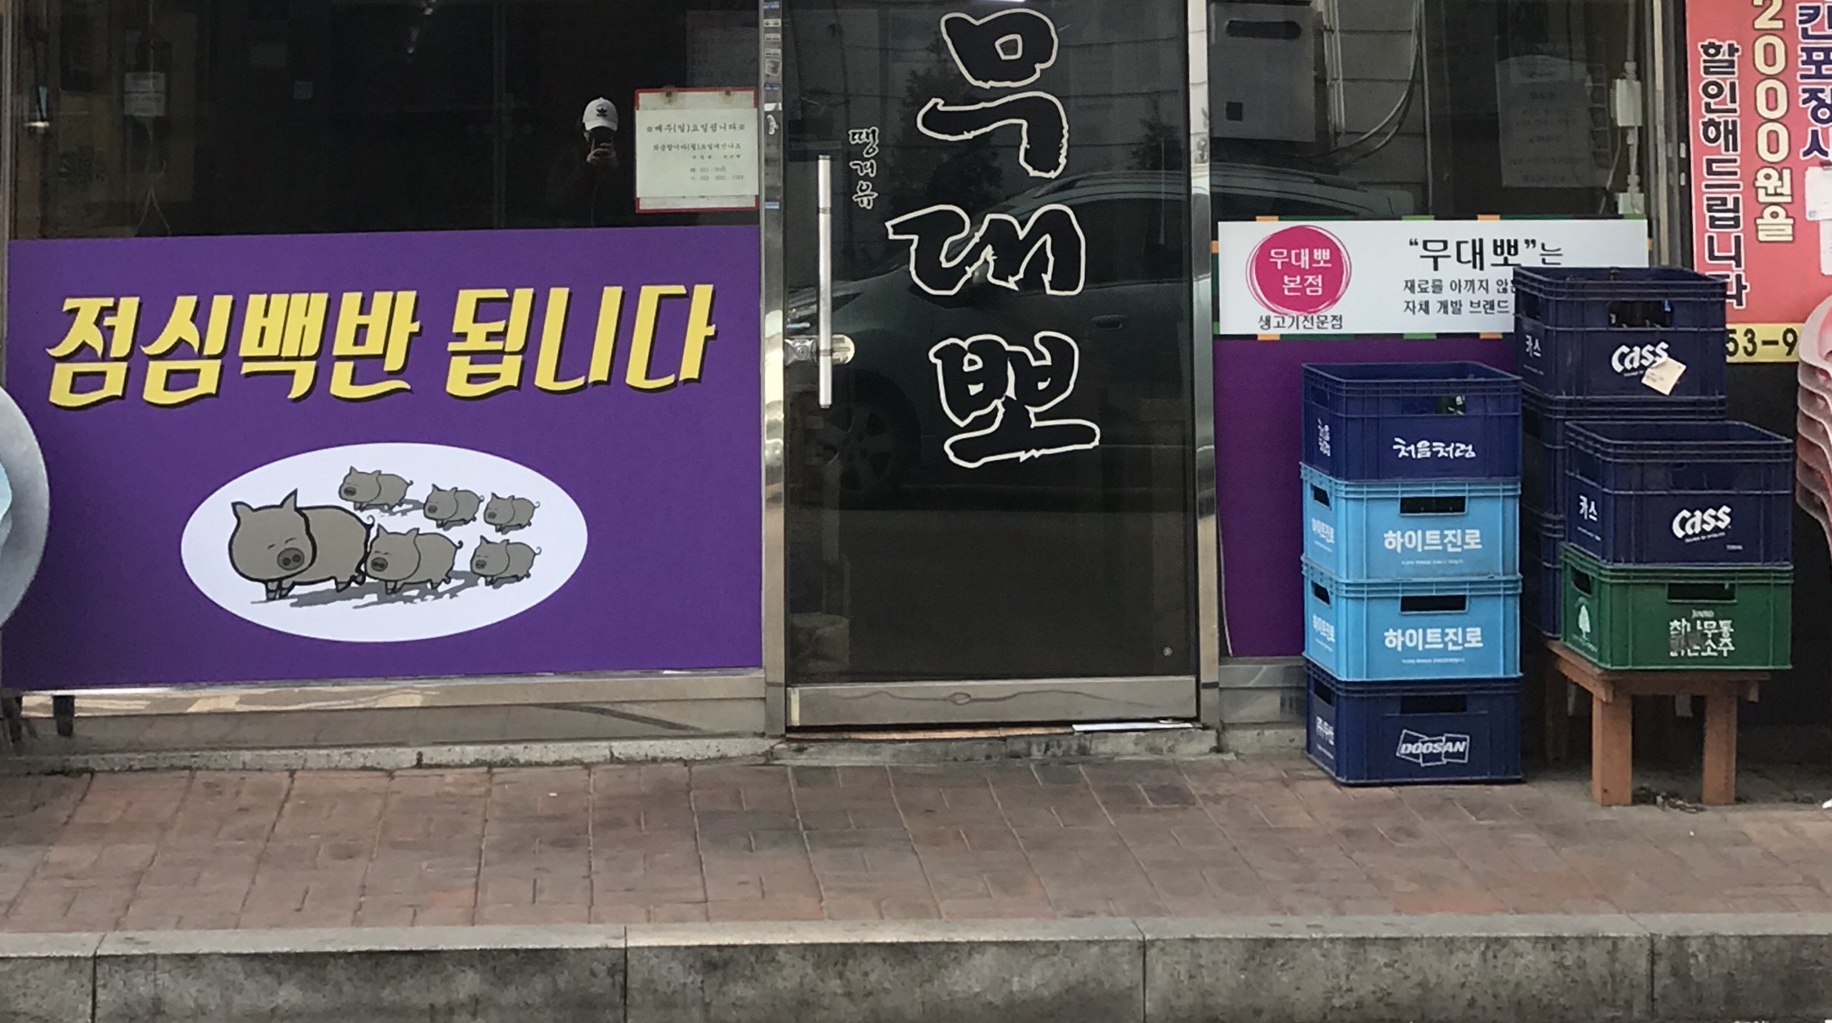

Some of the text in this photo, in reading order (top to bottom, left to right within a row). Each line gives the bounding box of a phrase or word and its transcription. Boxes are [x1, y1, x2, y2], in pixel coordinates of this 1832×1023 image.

[885, 8, 1101, 468] 무대뽀
[1269, 248, 1332, 269] 무대뽀
[1282, 274, 1323, 295] 본점
[1403, 278, 1444, 294] 재료를
[1449, 278, 1489, 294] 아끼지
[1404, 299, 1430, 315] 자체
[1437, 298, 1463, 315] 개발
[1259, 314, 1343, 331] 생고기전문점
[46, 284, 716, 408] 점심백반 됩니다
[1525, 334, 1542, 357] 카스
[1611, 341, 1670, 374] Cass
[1393, 437, 1477, 459] 처음처럼
[1579, 494, 1598, 521] 카스
[1672, 505, 1732, 539] Cass
[1384, 529, 1482, 553] 하이트진로
[1384, 627, 1484, 651] 하이트진로
[1400, 741, 1467, 755] DOOSAN
